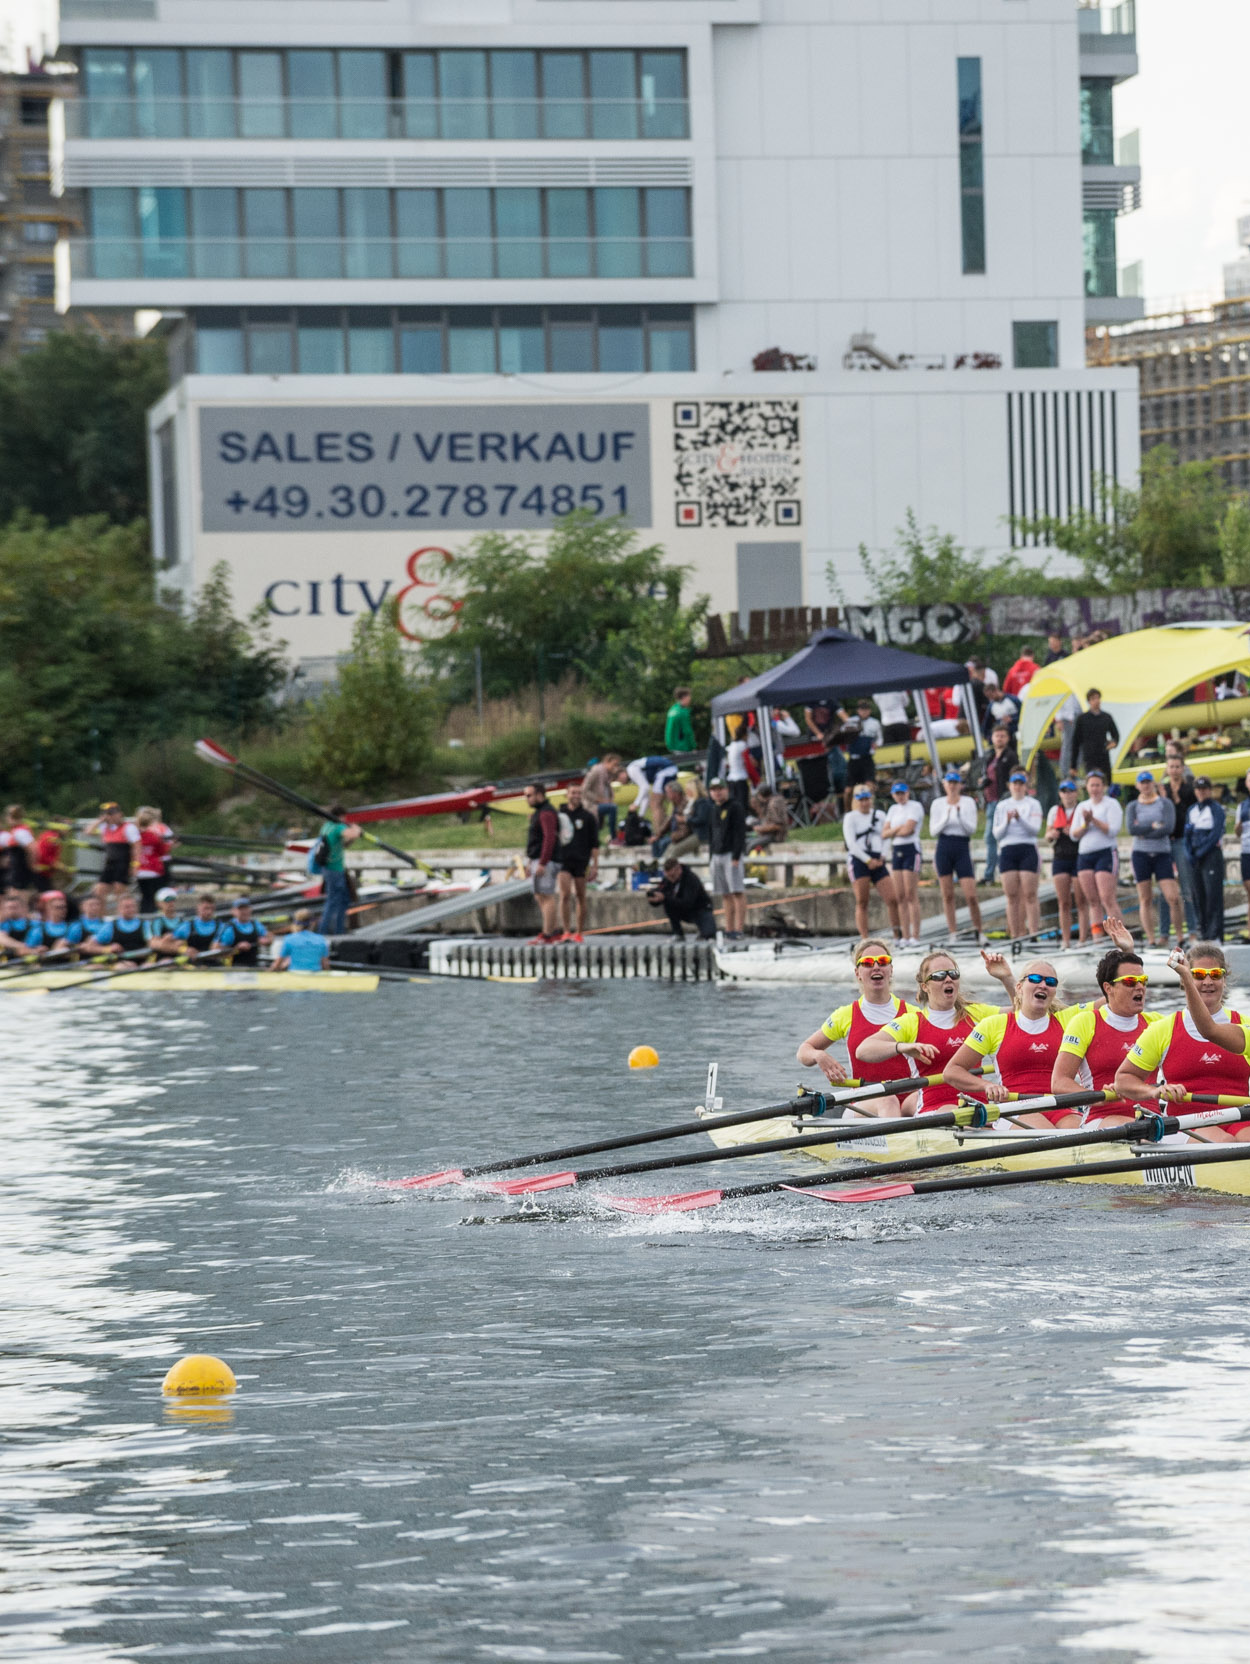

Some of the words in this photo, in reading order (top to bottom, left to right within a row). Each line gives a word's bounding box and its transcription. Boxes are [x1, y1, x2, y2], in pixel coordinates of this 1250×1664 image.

[219, 431, 374, 464] SALES
[387, 432, 401, 463] /
[413, 430, 636, 463] VERKAUF
[225, 483, 628, 519] +49.30.27874851
[1143, 1163, 1194, 1185] MINDEN
